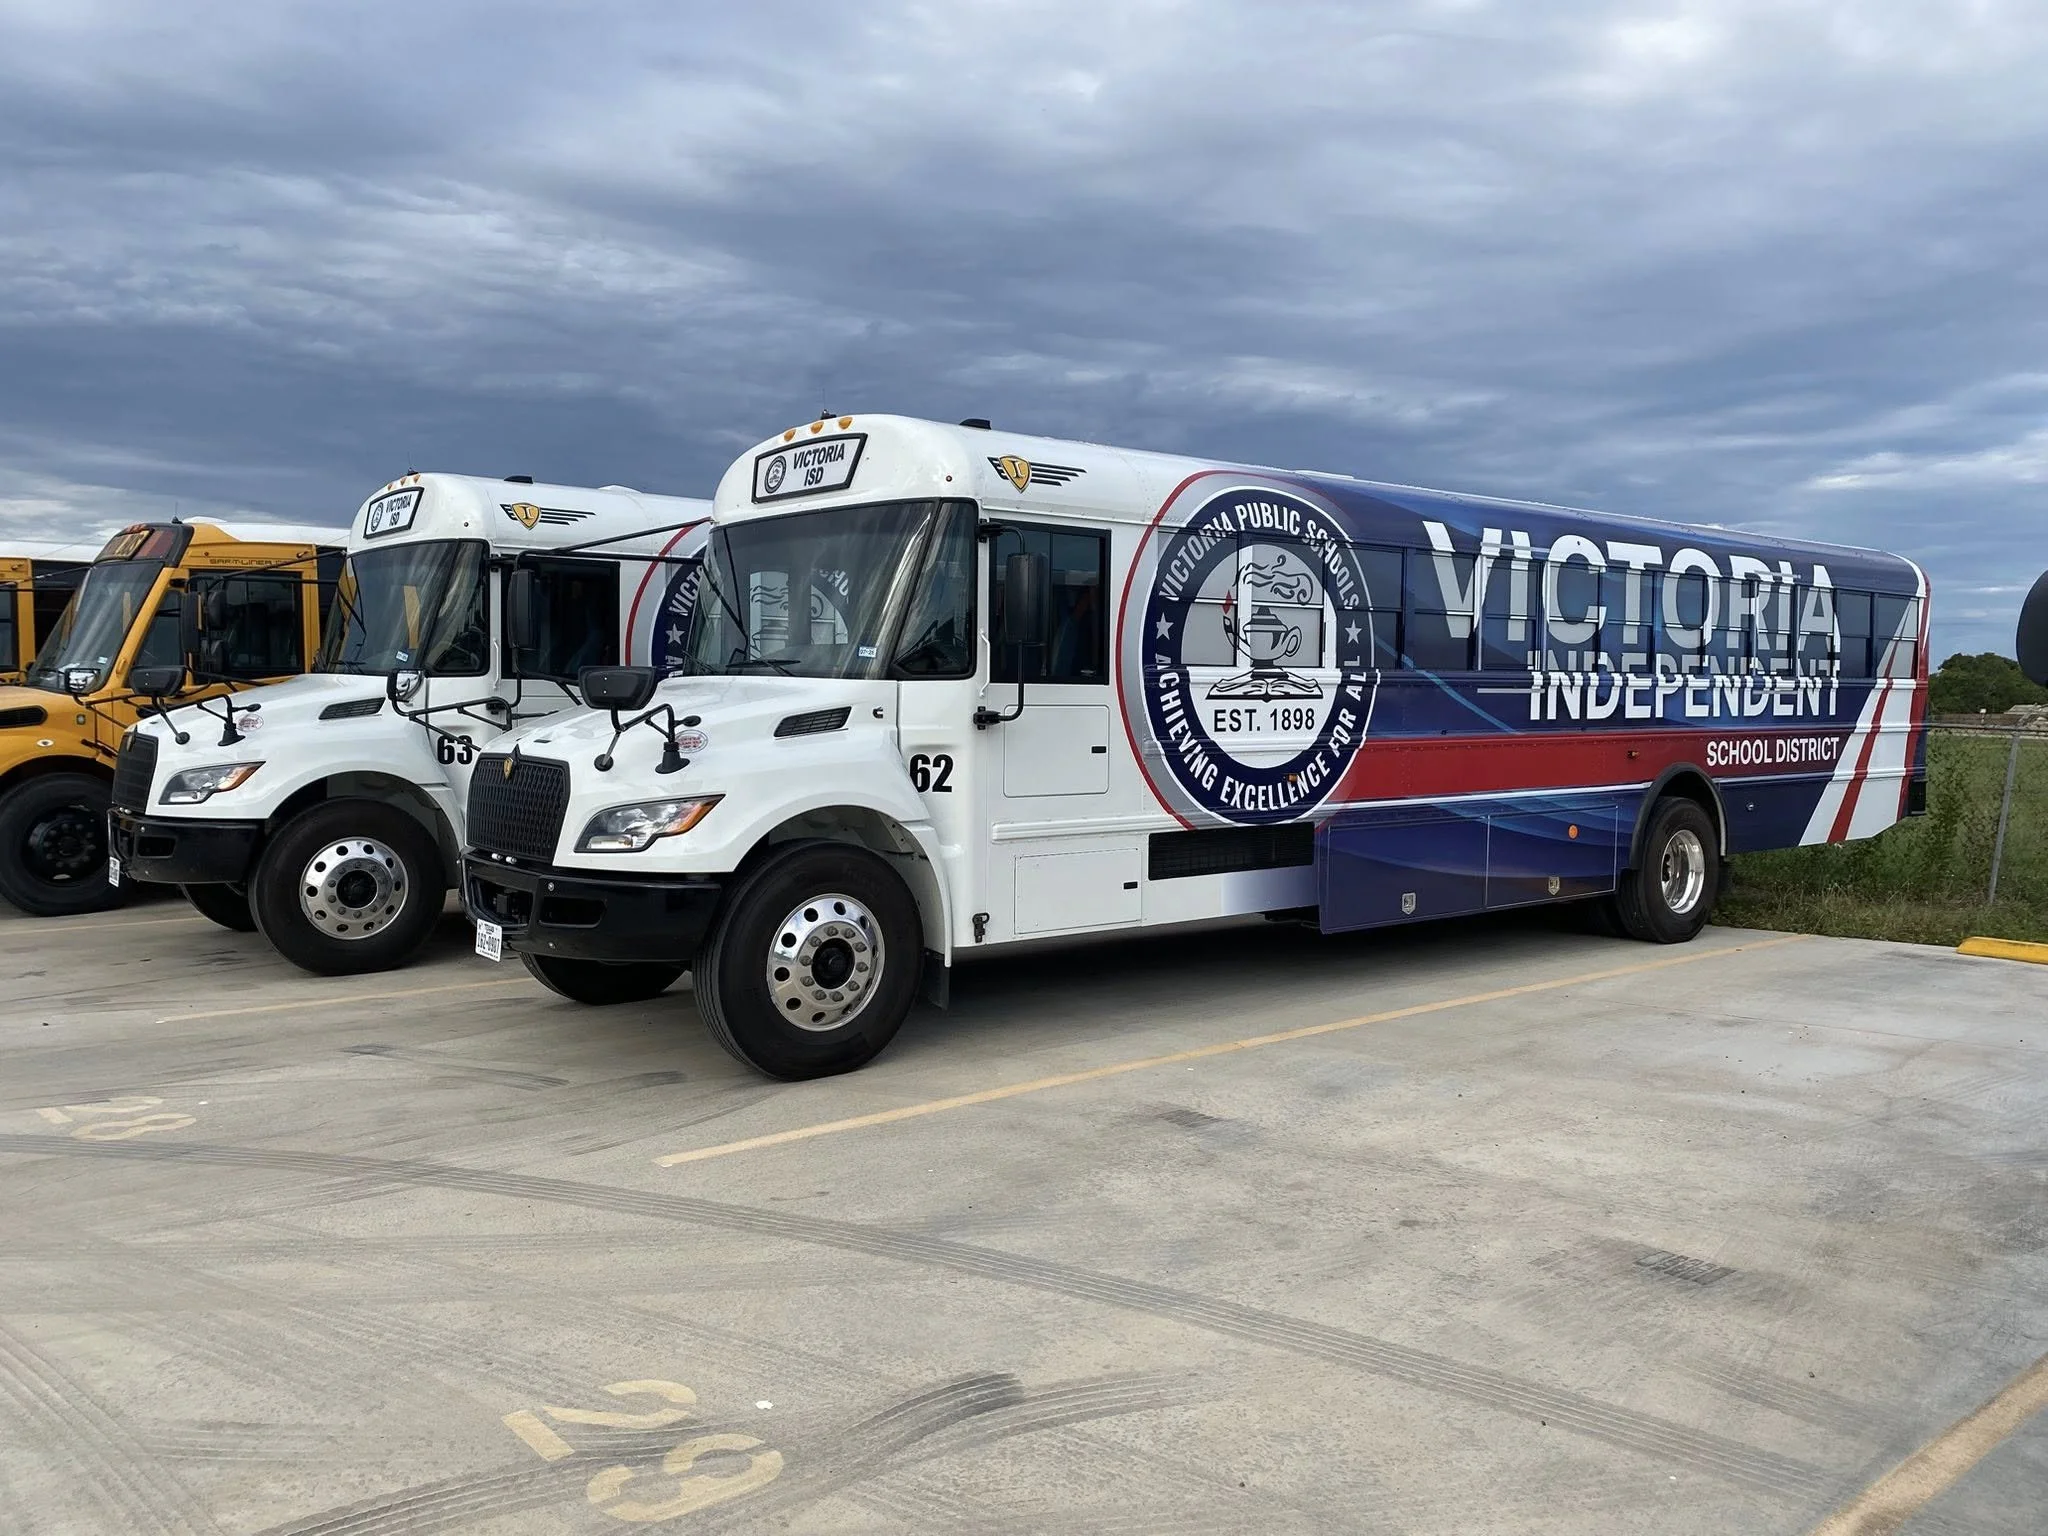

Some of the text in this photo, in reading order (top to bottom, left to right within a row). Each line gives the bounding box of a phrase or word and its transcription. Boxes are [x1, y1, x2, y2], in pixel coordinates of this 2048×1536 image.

[793, 442, 846, 469] VICTORIA
[803, 466, 824, 487] ISD
[386, 494, 412, 513] VICTORIA
[389, 511, 400, 526] ISD
[1159, 502, 1362, 611] VICTORIA PUBLIC SCHOOLS
[1422, 520, 1841, 654] VICTORIA
[1526, 650, 1841, 721] INDEPENDENT
[1155, 653, 1368, 812] ACHIEVING EXCELLENCE FOR ALL
[1213, 707, 1316, 733] EST. 1898
[437, 735, 473, 765] 63
[1706, 736, 1840, 767] SCHOOL DISTRICT
[909, 753, 954, 793] 62
[502, 1378, 784, 1523] 29
